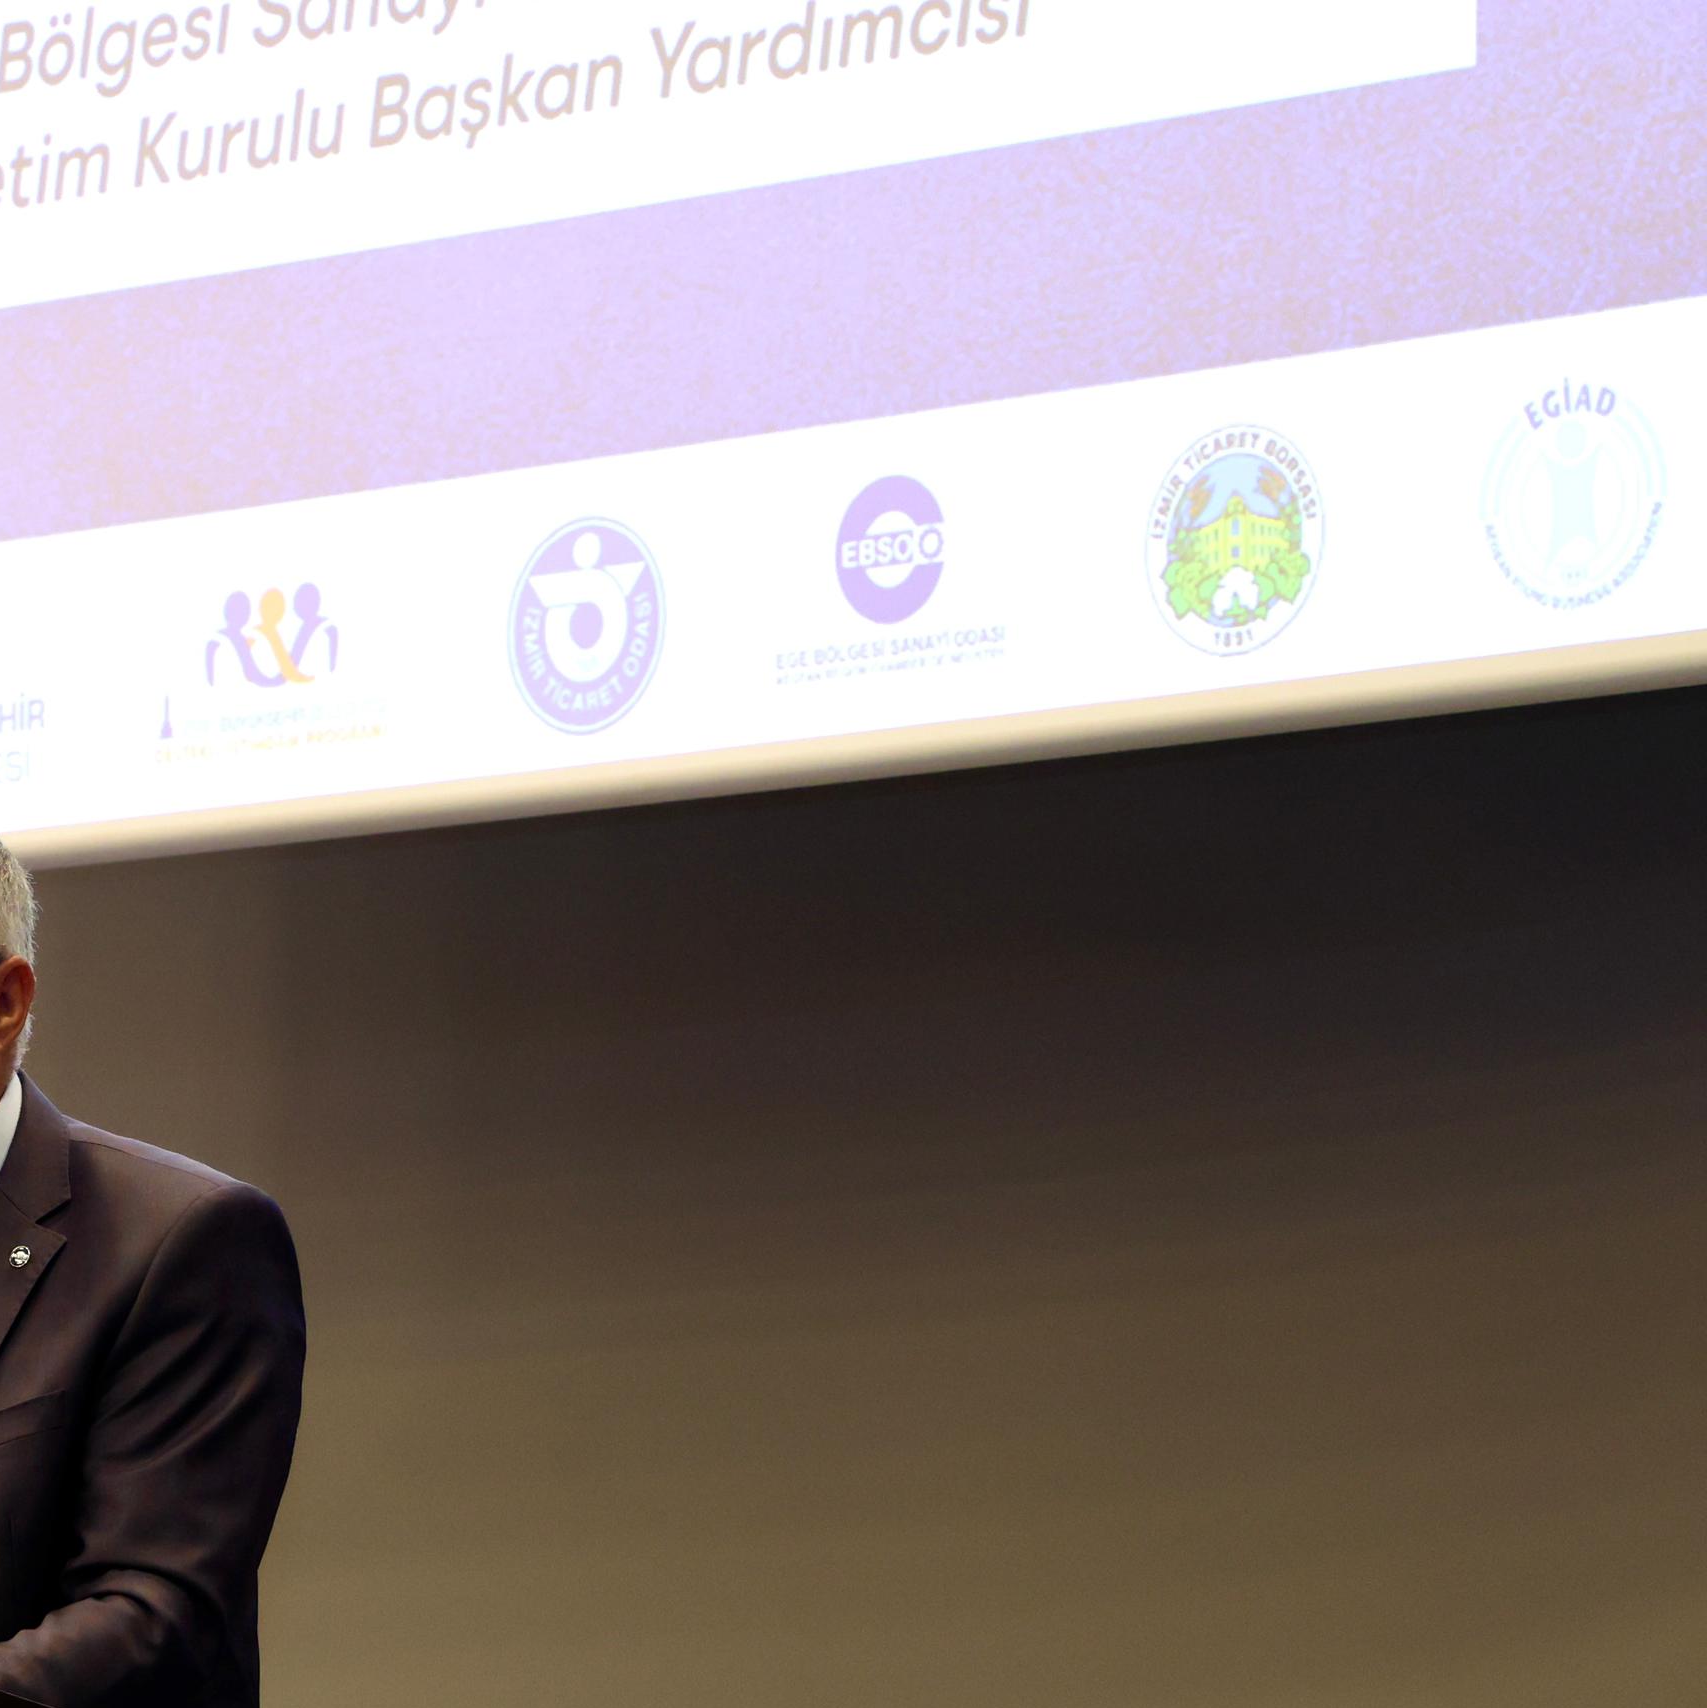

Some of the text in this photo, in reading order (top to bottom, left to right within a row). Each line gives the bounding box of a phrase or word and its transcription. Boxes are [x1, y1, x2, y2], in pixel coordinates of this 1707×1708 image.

[133, 88, 345, 187] Kurulu
[369, 53, 623, 149] Başkan
[650, 0, 1030, 99] Yardımcısı
[1523, 377, 1616, 430] EGİAD
